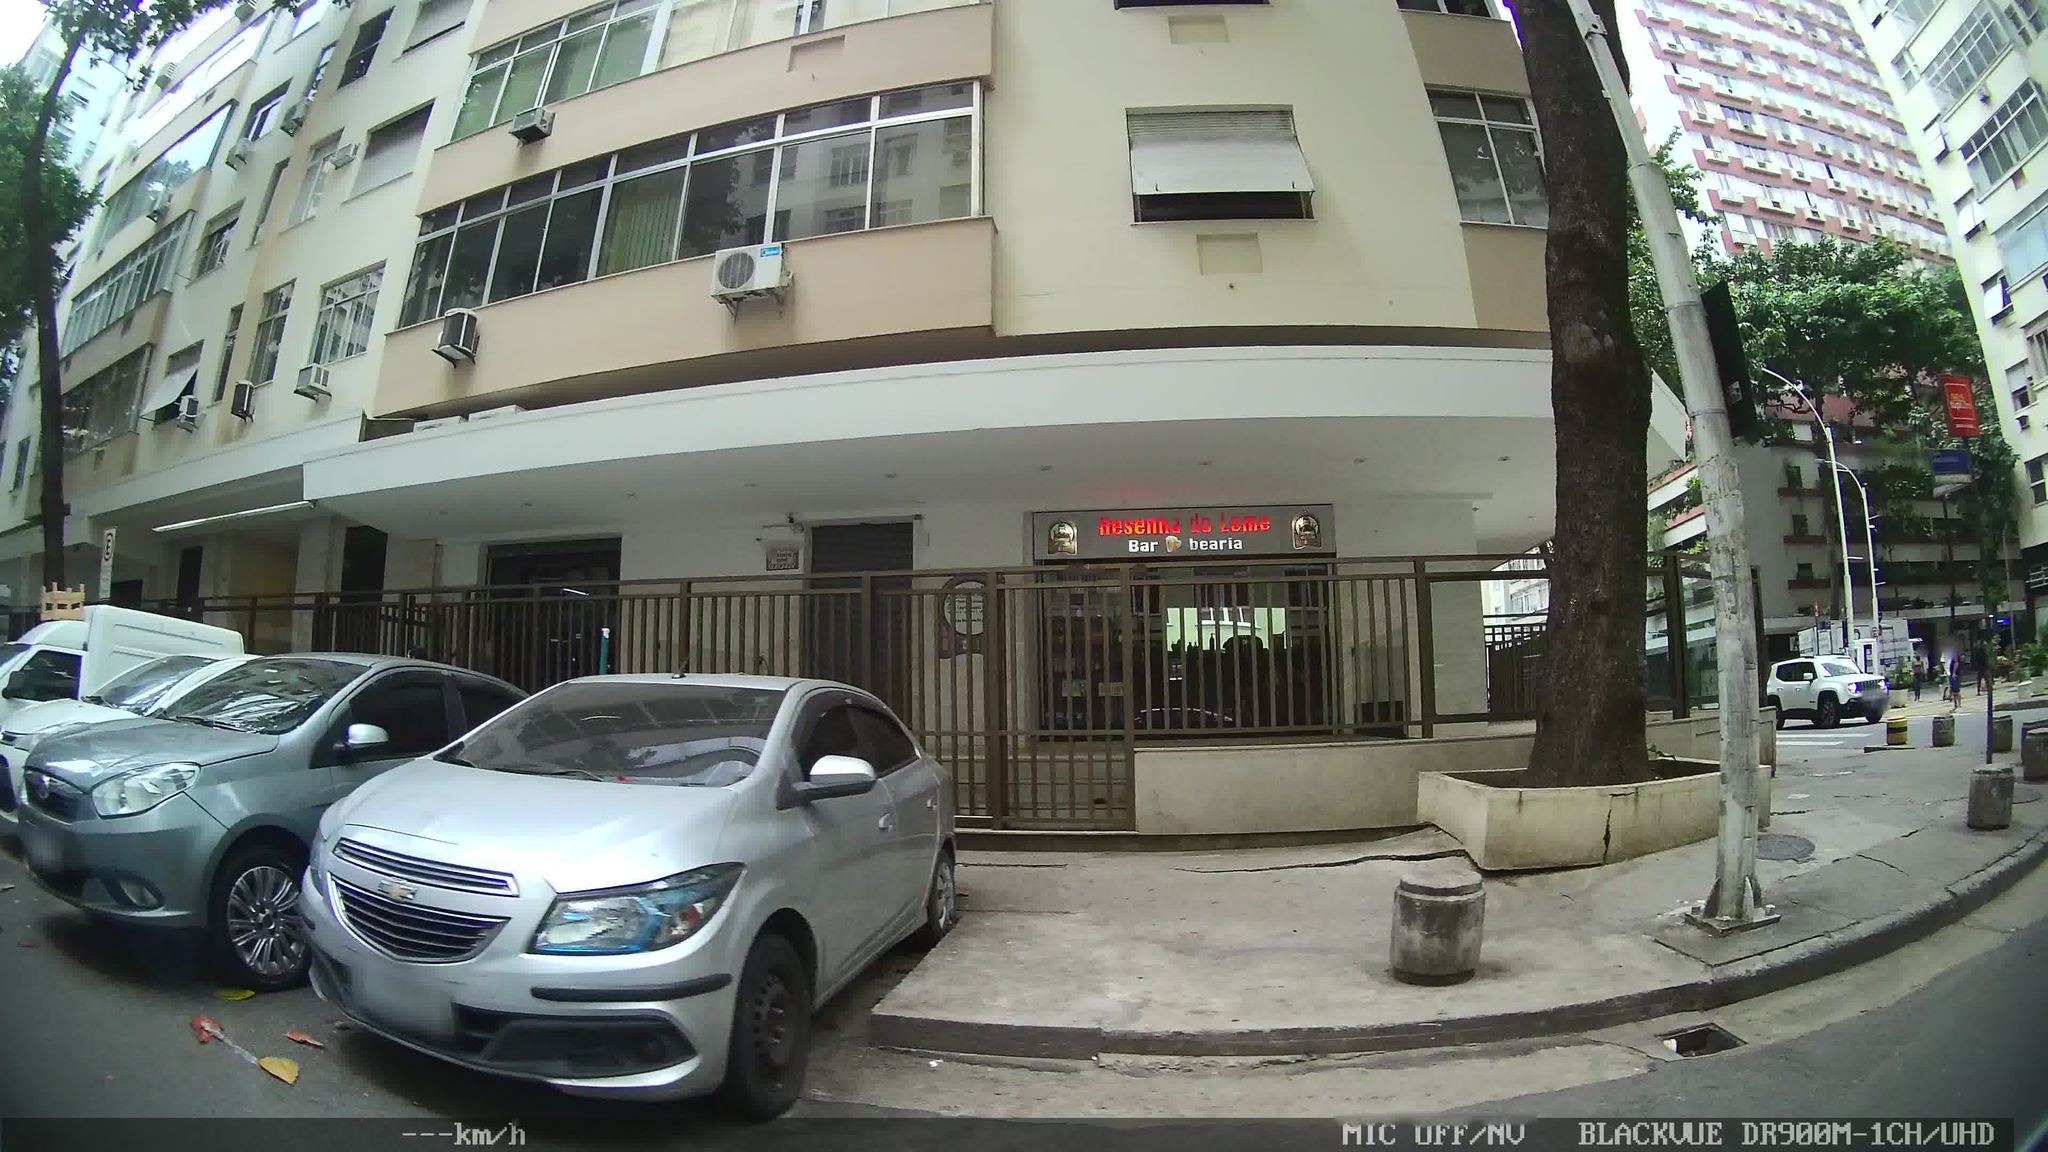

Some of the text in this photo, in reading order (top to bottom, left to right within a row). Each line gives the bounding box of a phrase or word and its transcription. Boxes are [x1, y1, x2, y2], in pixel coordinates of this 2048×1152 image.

[1189, 512, 1213, 534] do
[1220, 511, 1271, 533] Leme
[1128, 537, 1243, 553] Bar bearia
